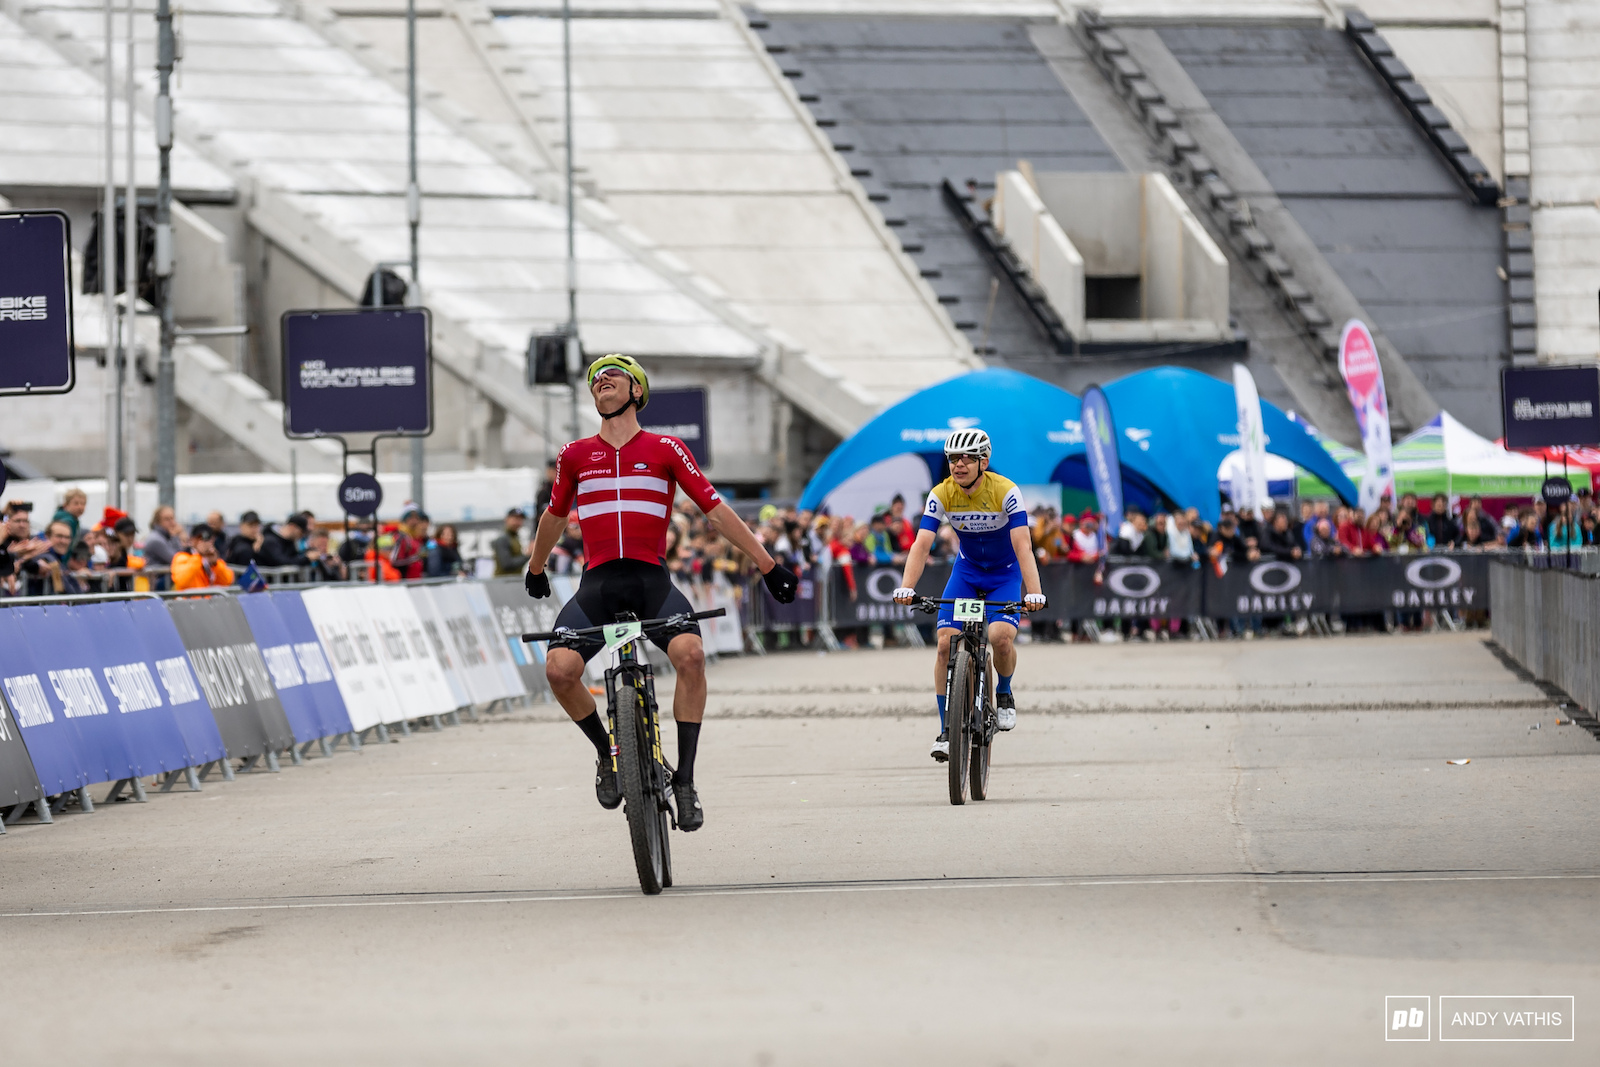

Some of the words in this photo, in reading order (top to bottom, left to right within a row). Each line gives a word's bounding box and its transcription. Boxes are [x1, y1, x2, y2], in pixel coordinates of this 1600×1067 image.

[0, 296, 47, 309] BIKE
[579, 469, 611, 478] postnord
[1391, 587, 1475, 608] OAKLEY
[959, 602, 981, 614] 15
[615, 625, 629, 638] 5
[186, 646, 248, 709] WHOOP
[48, 667, 109, 718] SHIMANO
[103, 662, 163, 714] SHIMANO
